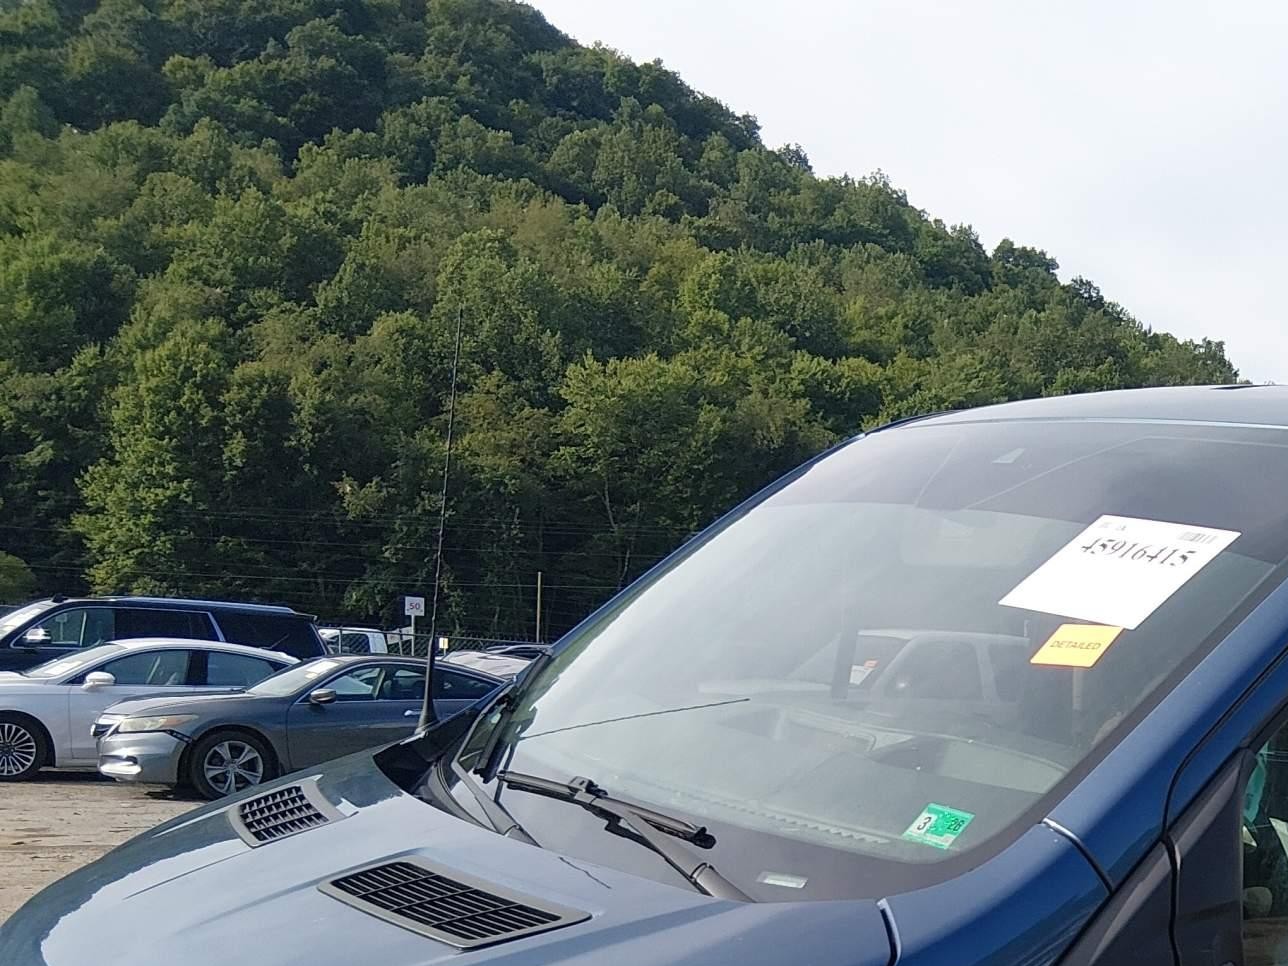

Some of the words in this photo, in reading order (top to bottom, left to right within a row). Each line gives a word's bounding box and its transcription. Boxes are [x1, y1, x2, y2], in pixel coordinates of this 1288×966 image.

[1081, 537, 1198, 567] 45916415
[1049, 640, 1102, 650] DETAILED
[916, 816, 932, 831] 3
